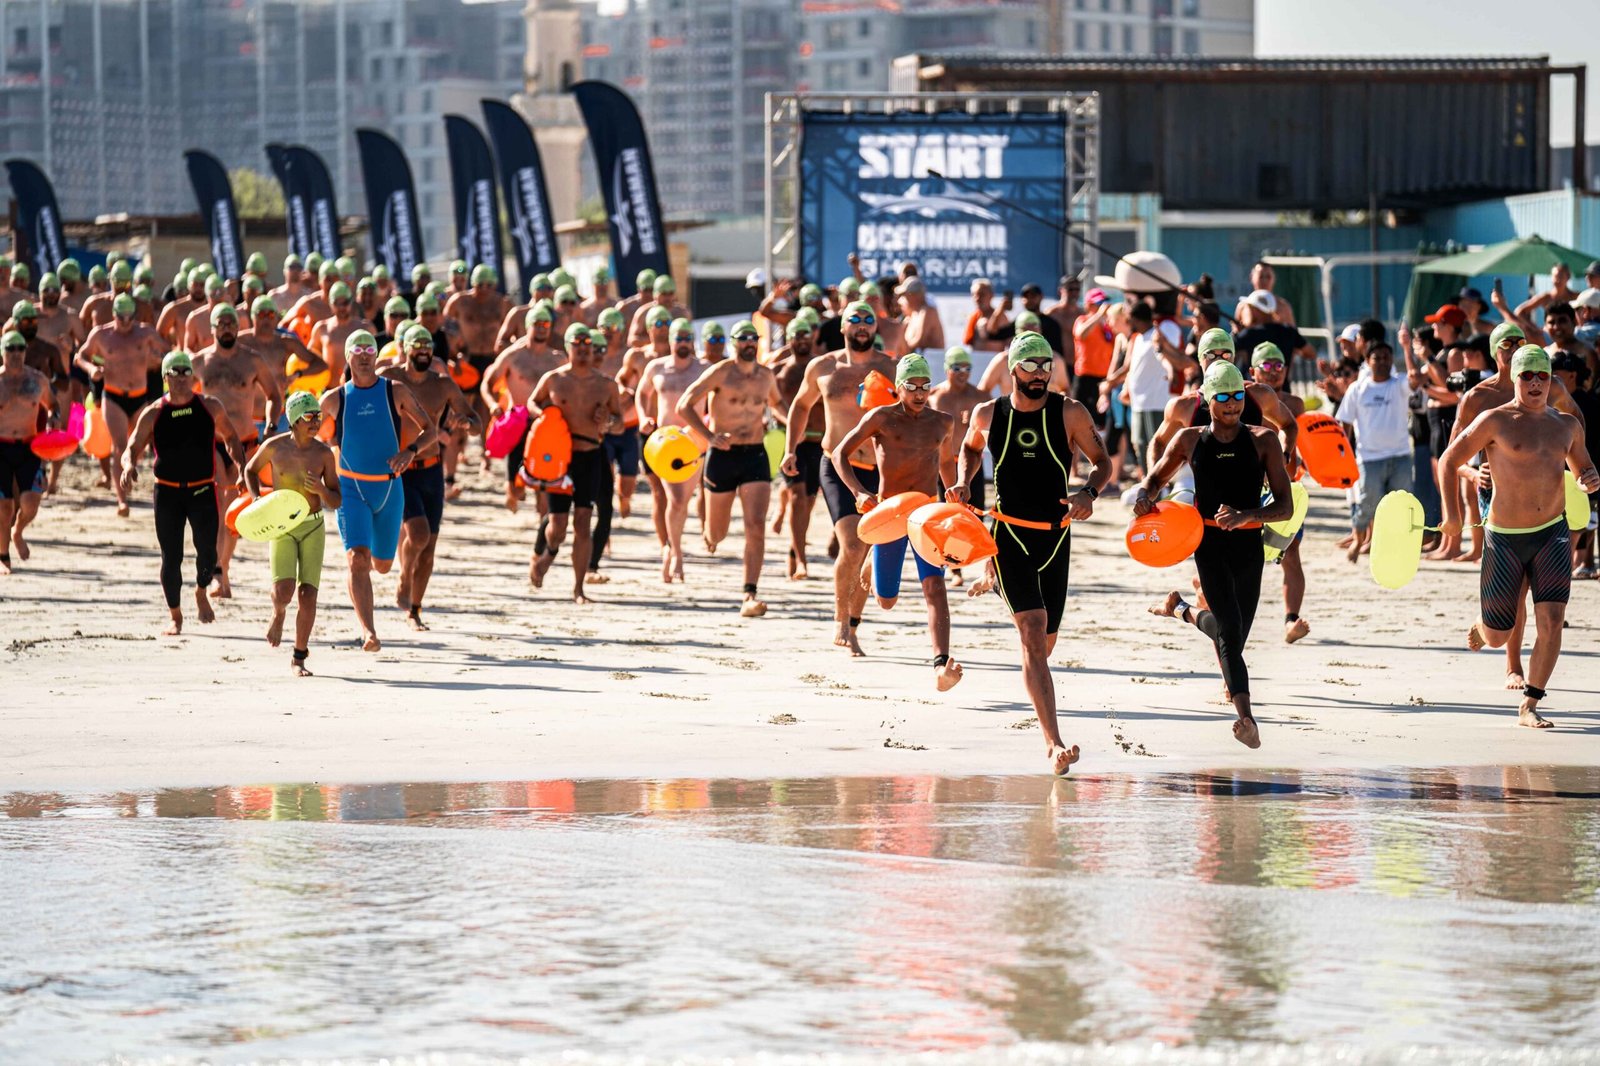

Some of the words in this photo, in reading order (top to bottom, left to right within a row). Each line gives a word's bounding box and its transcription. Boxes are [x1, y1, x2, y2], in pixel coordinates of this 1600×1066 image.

[858, 134, 1009, 179] START
[622, 147, 657, 255] OCEANMAN
[857, 223, 1008, 251] OCEANMAN
